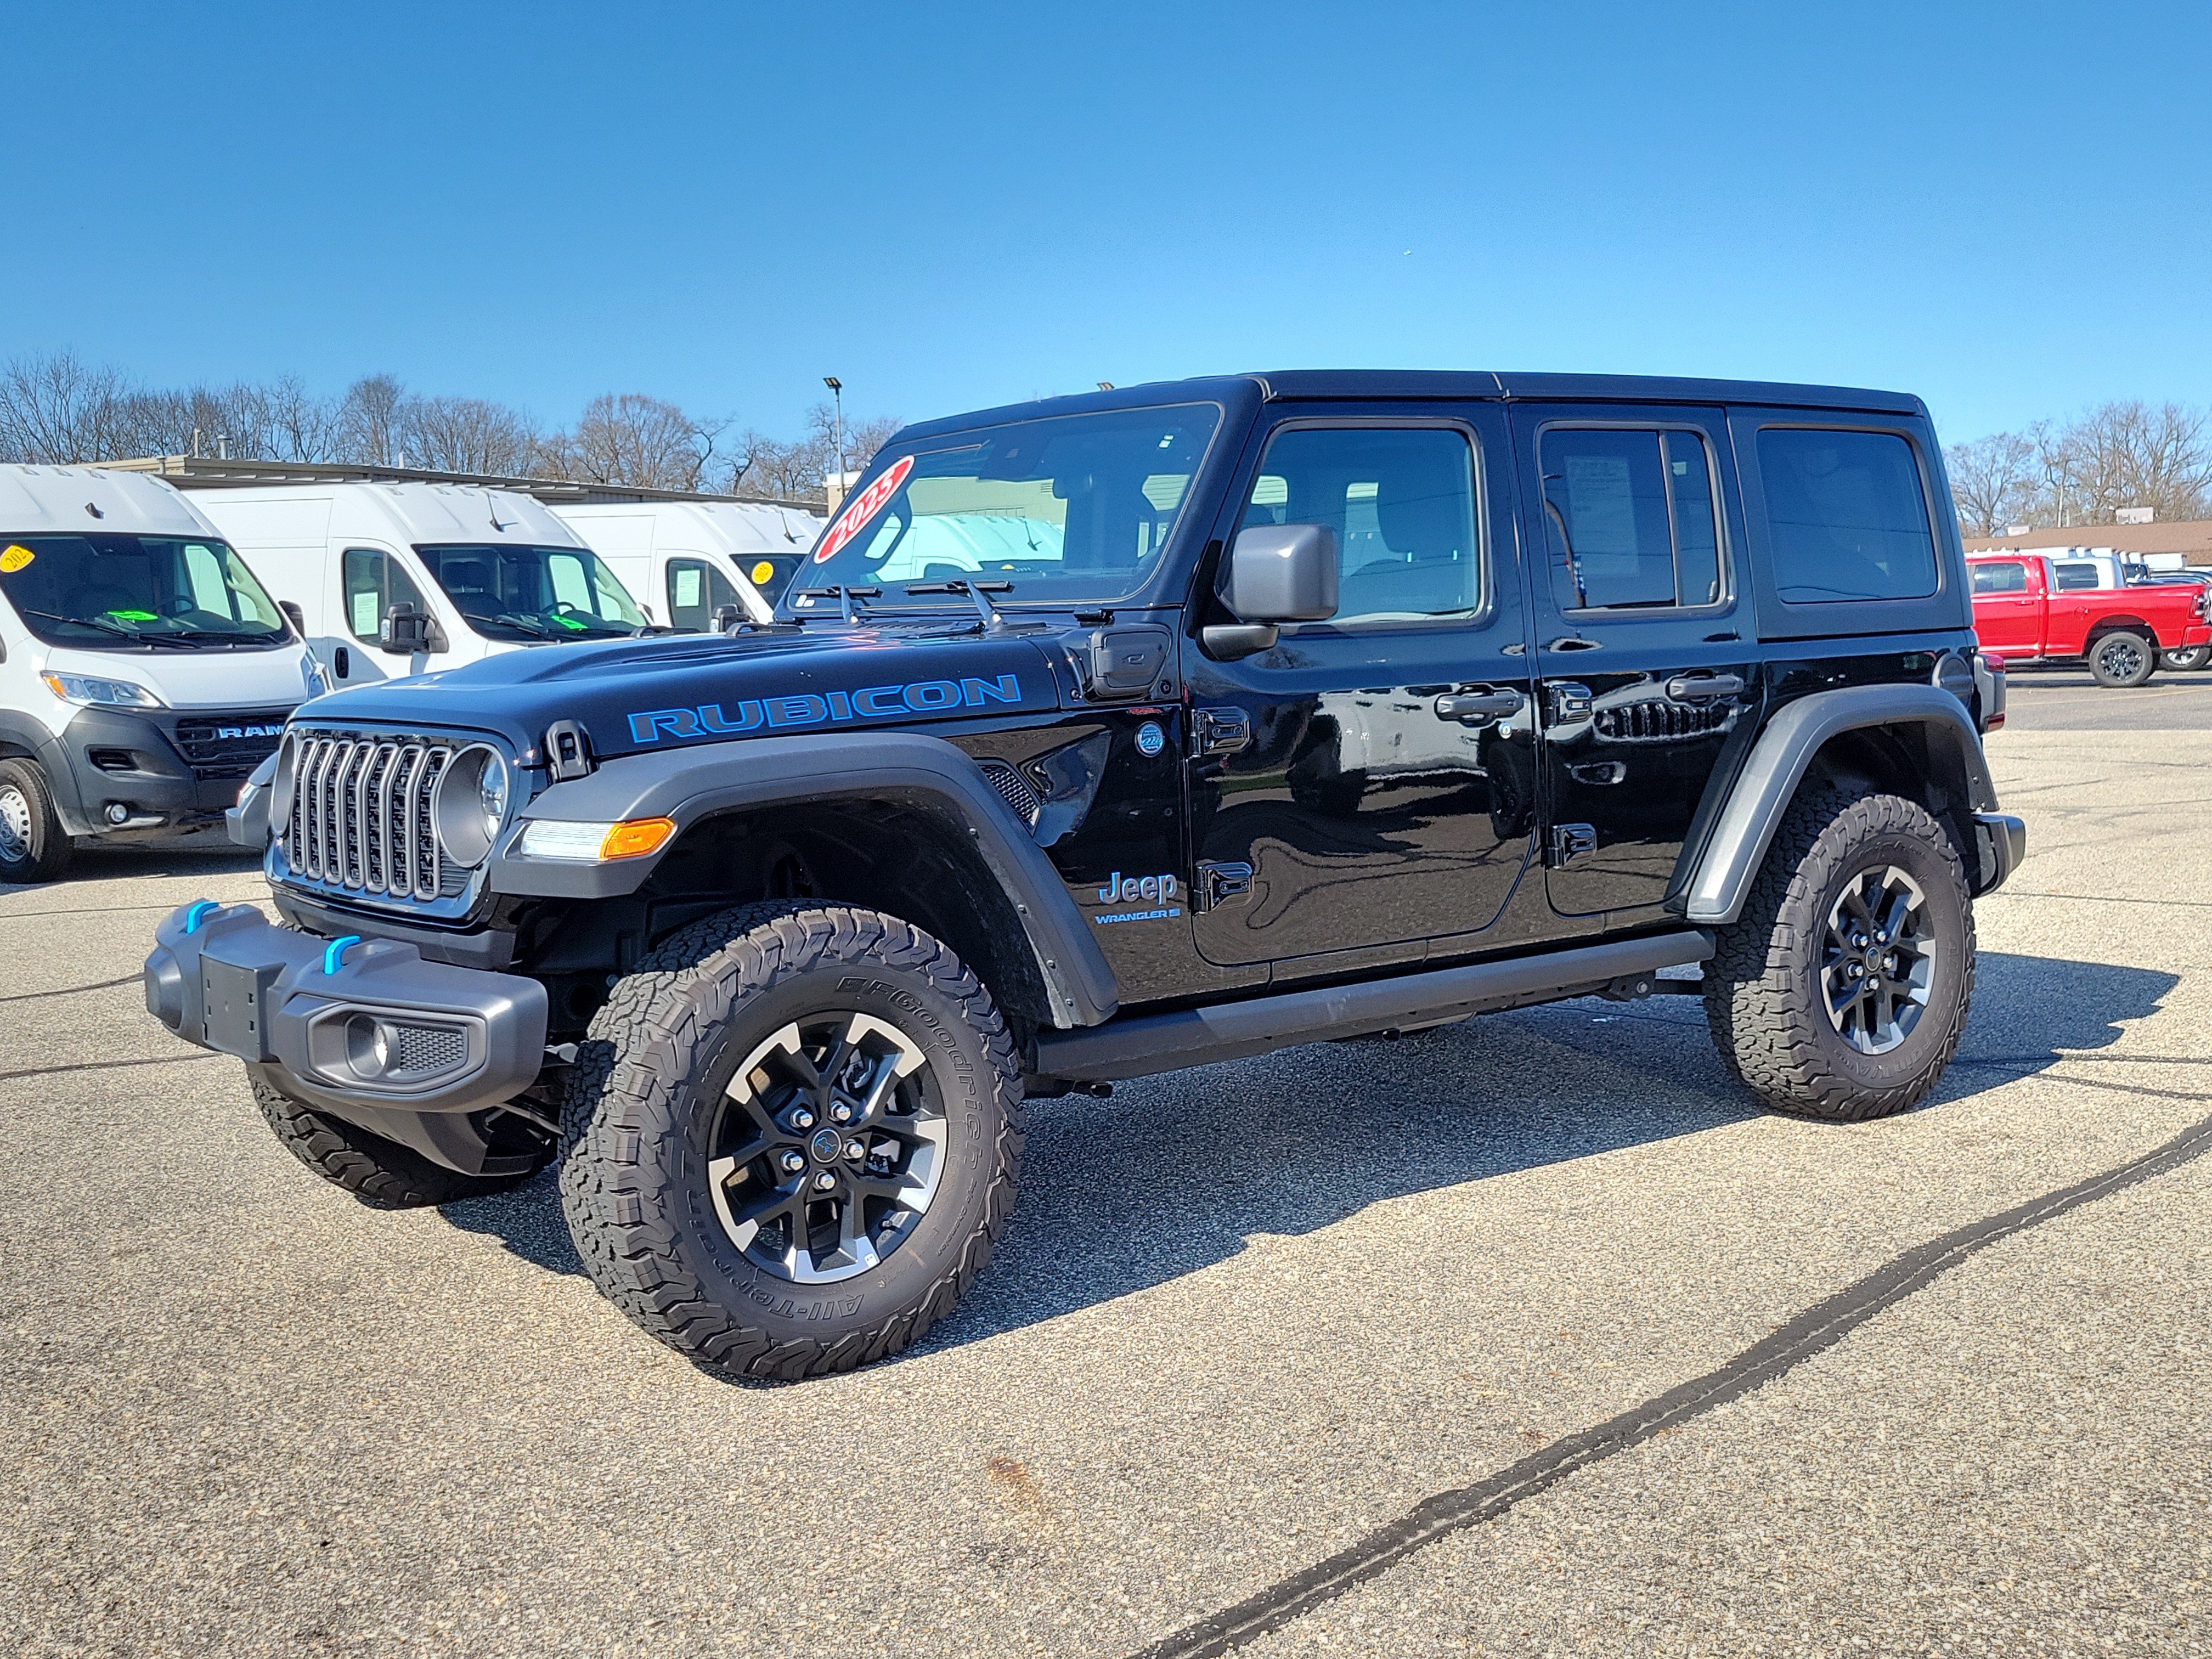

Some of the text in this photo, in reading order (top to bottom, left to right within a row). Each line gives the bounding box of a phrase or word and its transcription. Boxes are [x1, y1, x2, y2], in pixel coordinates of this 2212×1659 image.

[832, 467, 895, 551] 2025
[5, 549, 30, 568] 202
[627, 674, 1022, 743] RUBICON
[218, 725, 284, 738] RAM
[1099, 872, 1178, 905] Jeep
[1095, 910, 1167, 924] WRANGLER
[835, 976, 983, 1170] BFGoodrich
